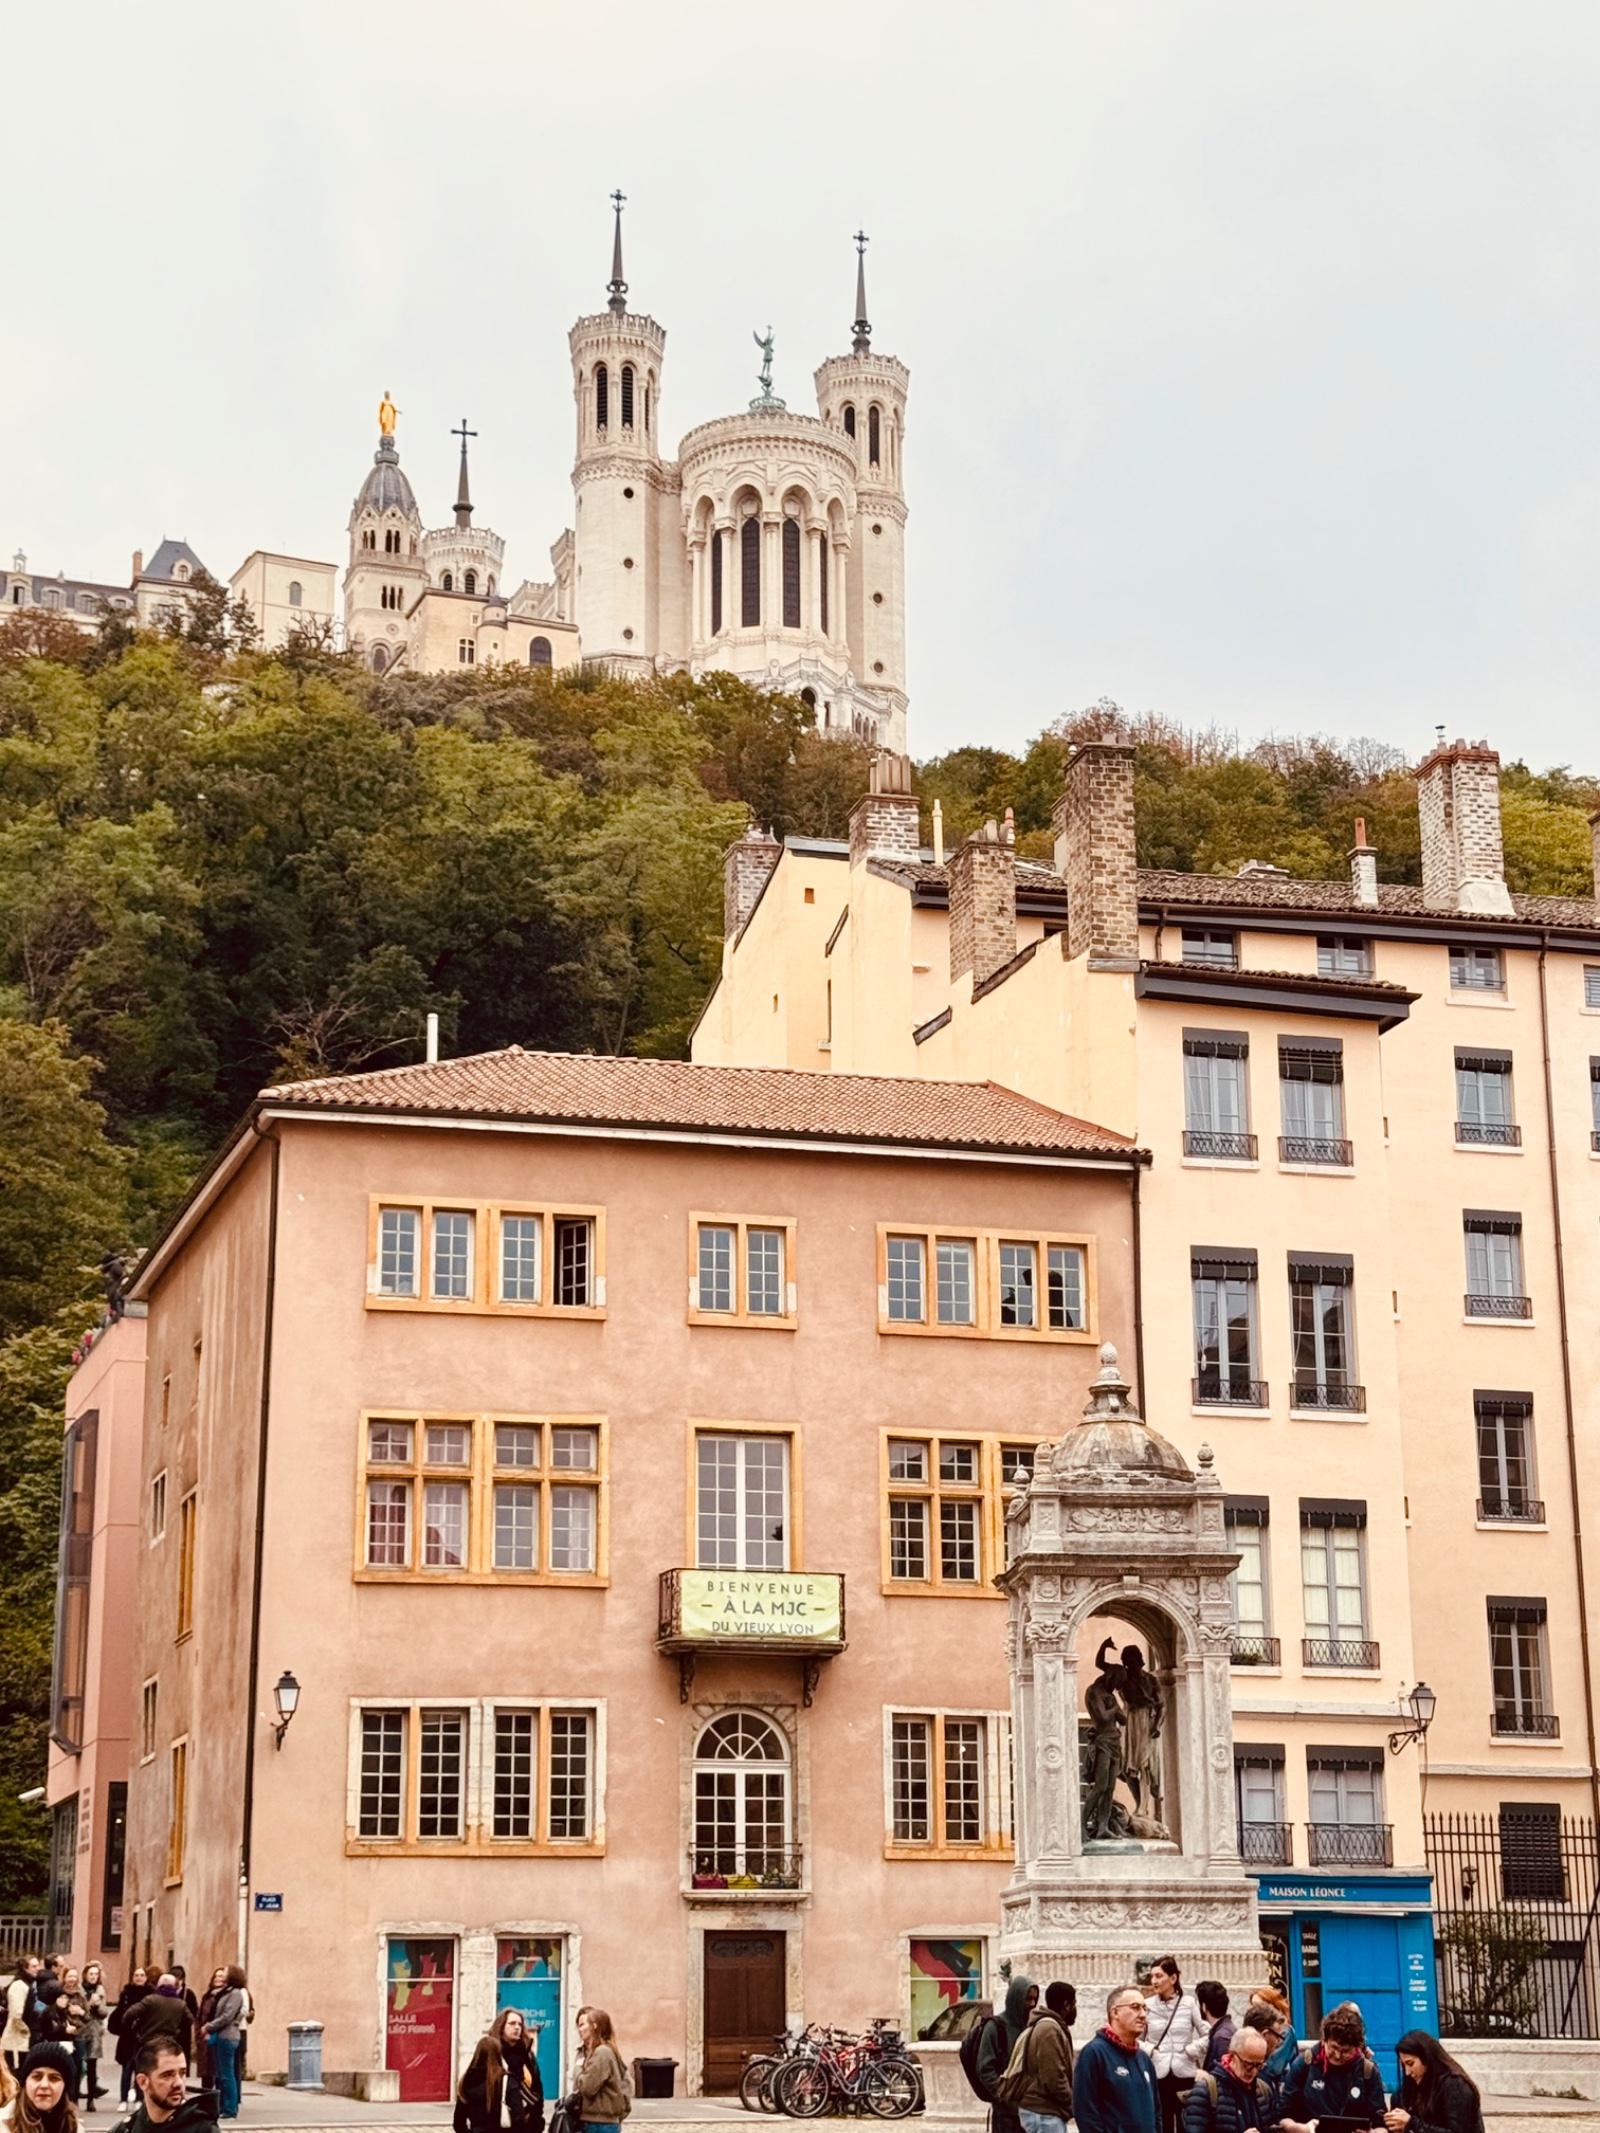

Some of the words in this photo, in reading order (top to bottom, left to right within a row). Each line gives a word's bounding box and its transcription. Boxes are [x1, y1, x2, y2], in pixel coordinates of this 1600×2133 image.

[707, 1580, 815, 1596] BIENVENUE
[723, 1595, 736, 1614] À
[743, 1600, 764, 1615] LA
[771, 1601, 808, 1616] MJC
[712, 1621, 729, 1632] DU
[735, 1622, 776, 1634] VIEUX
[780, 1623, 814, 1635] LYON
[1269, 1887, 1307, 1897] MAISON
[1309, 1886, 1346, 1898] LÉONCE
[388, 2014, 417, 2023] SALLE
[388, 2023, 406, 2034] LÉO
